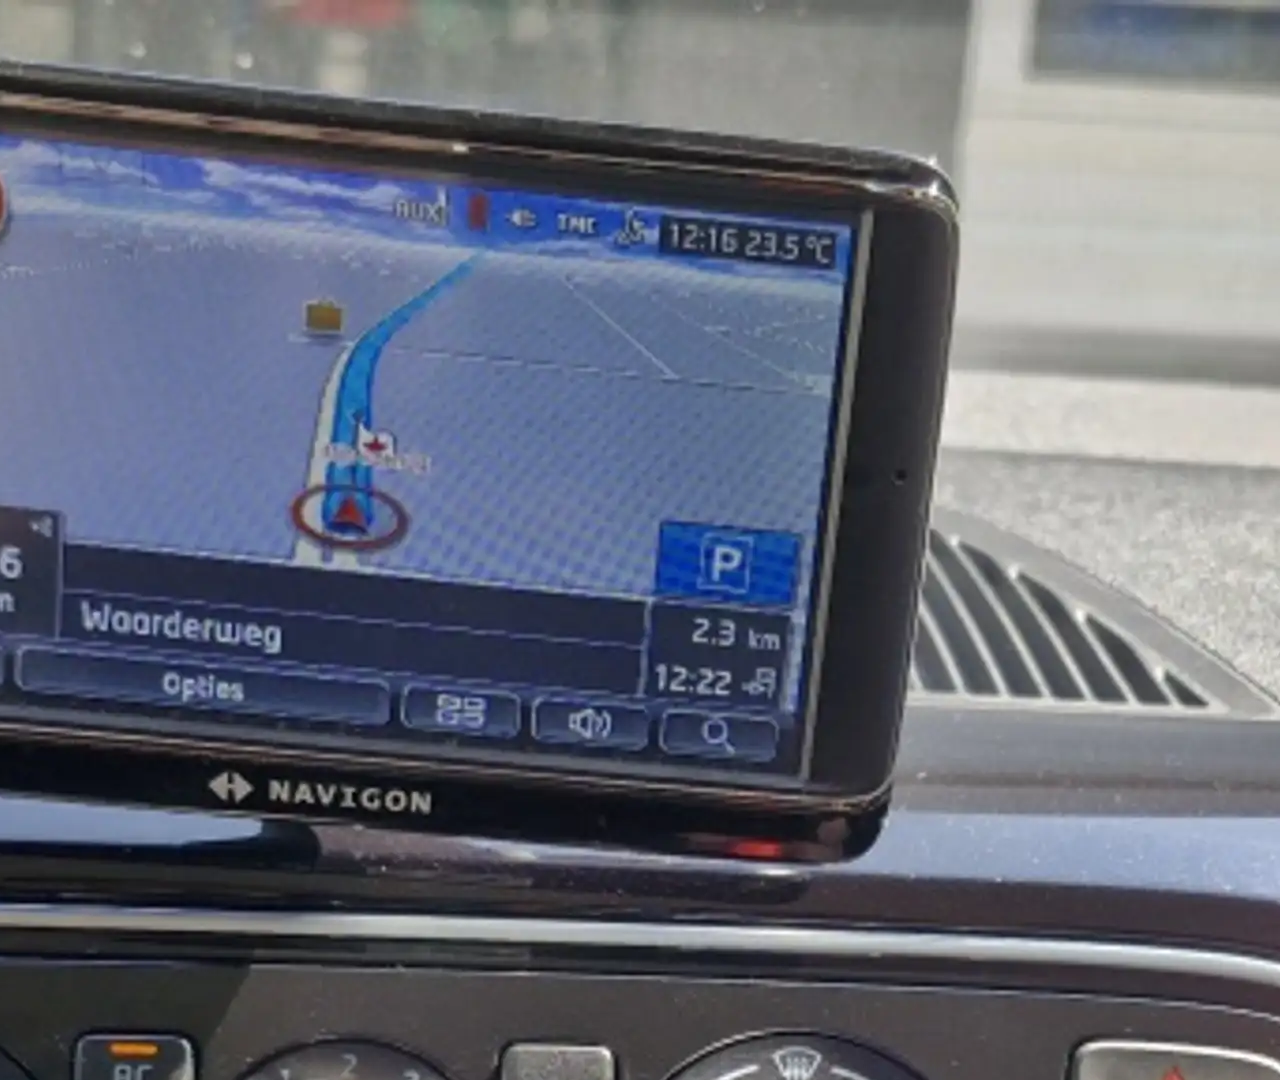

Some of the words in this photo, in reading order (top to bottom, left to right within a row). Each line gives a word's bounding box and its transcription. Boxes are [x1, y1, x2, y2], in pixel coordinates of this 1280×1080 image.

[557, 214, 596, 233] TMC
[669, 224, 737, 252] 12:16
[744, 232, 800, 260] 23.5
[712, 546, 743, 581] P
[81, 601, 283, 653] Waarderweg
[692, 617, 736, 646] 2.3
[748, 628, 780, 650] km
[162, 672, 245, 704] Opties
[655, 663, 731, 695] 12:22
[268, 779, 433, 815] NAVIGON
[340, 1054, 359, 1079] 2
